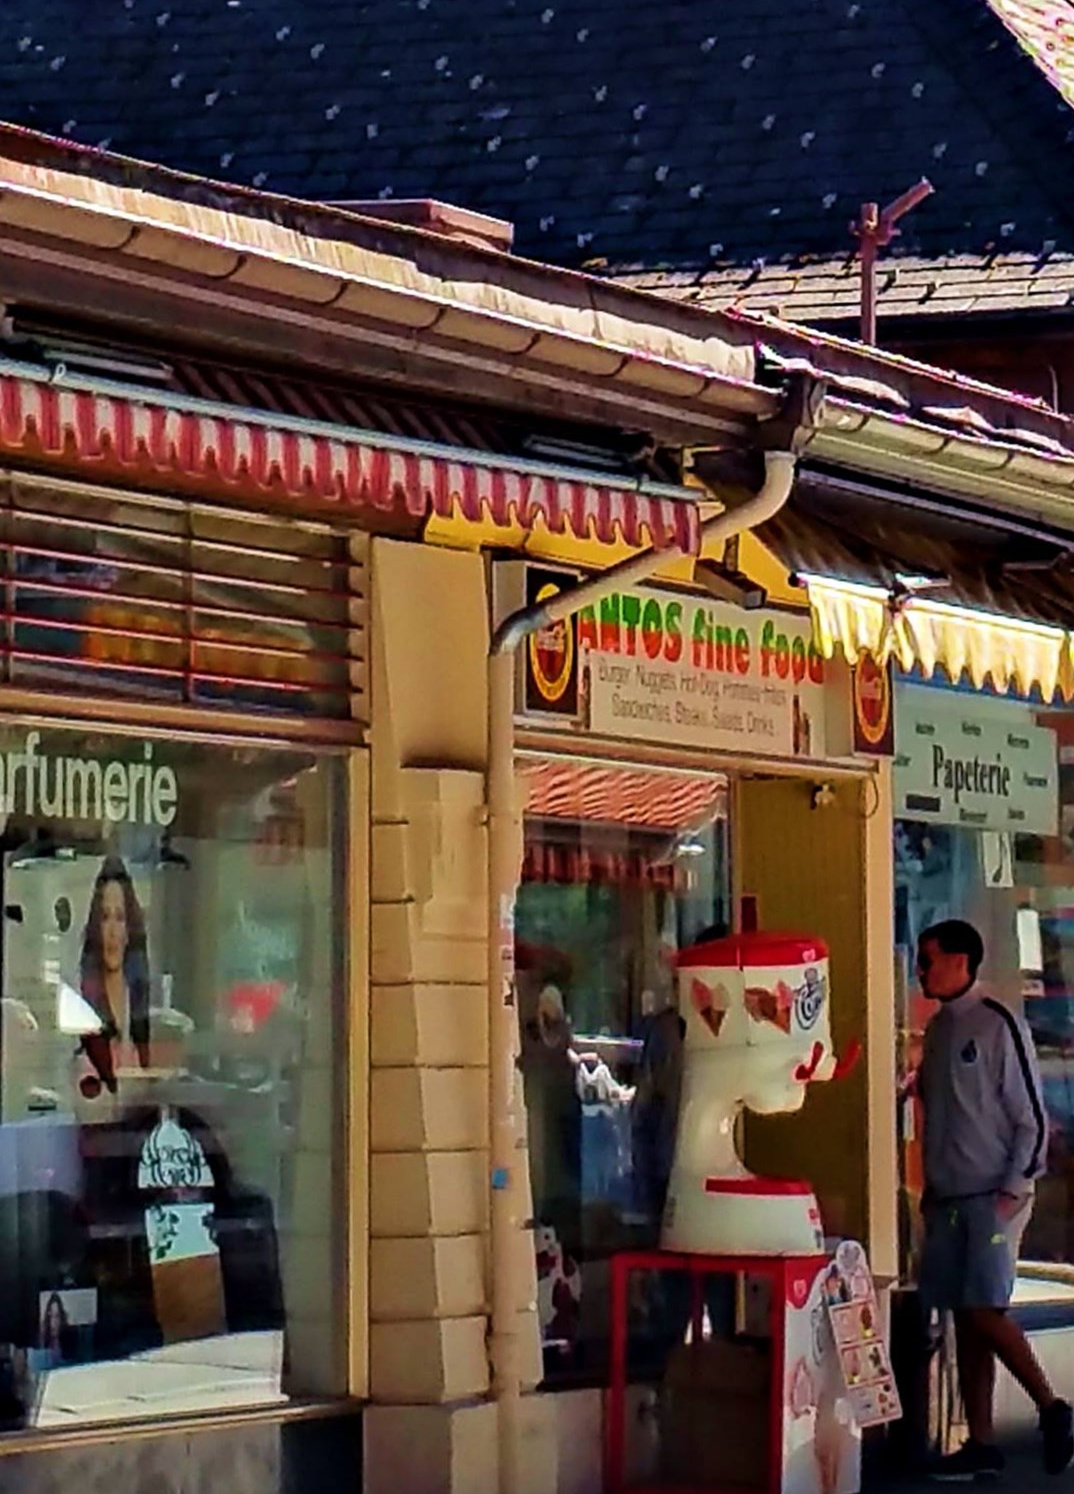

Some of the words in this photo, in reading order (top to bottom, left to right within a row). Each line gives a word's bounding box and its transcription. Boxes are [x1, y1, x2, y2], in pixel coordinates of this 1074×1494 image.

[578, 592, 683, 663] ANTOS
[691, 606, 751, 676] fine
[759, 618, 825, 685] food
[0, 731, 178, 826] rfumerie
[932, 744, 1011, 804] Papeterie
